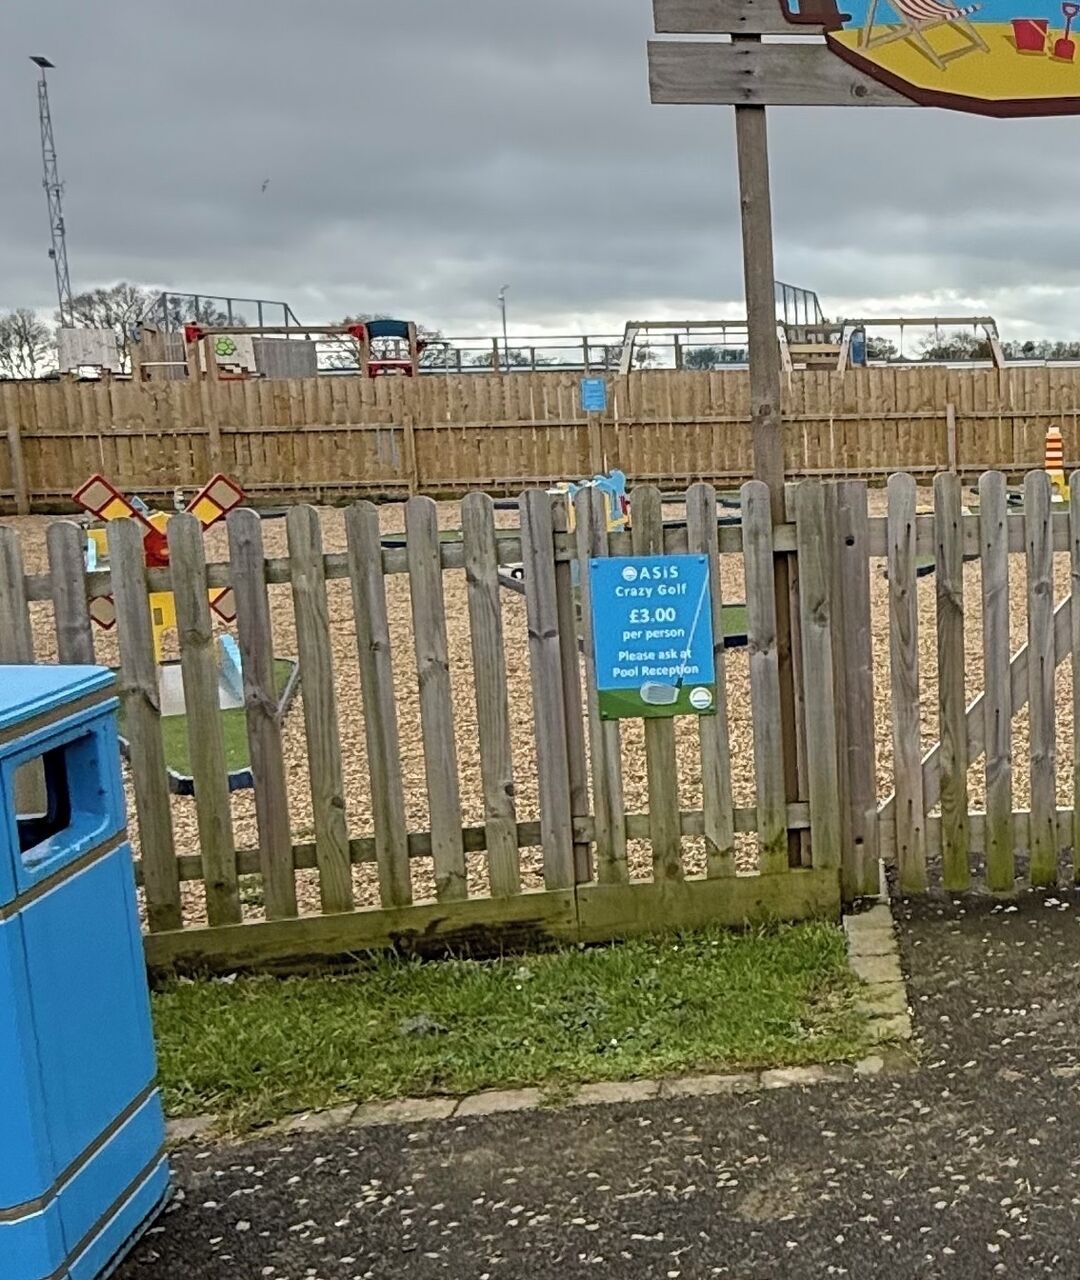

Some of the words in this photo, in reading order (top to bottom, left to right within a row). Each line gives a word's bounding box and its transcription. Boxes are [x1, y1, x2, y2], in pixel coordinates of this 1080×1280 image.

[615, 585, 652, 598] Crazy
[657, 583, 687, 596] Golf
[629, 607, 676, 624] £3.00
[622, 629, 642, 642] per
[645, 627, 685, 641] person
[618, 650, 655, 662] Please
[658, 649, 678, 661] ask
[680, 648, 692, 659] at
[612, 666, 639, 678] Pool
[641, 664, 699, 678] Reception
